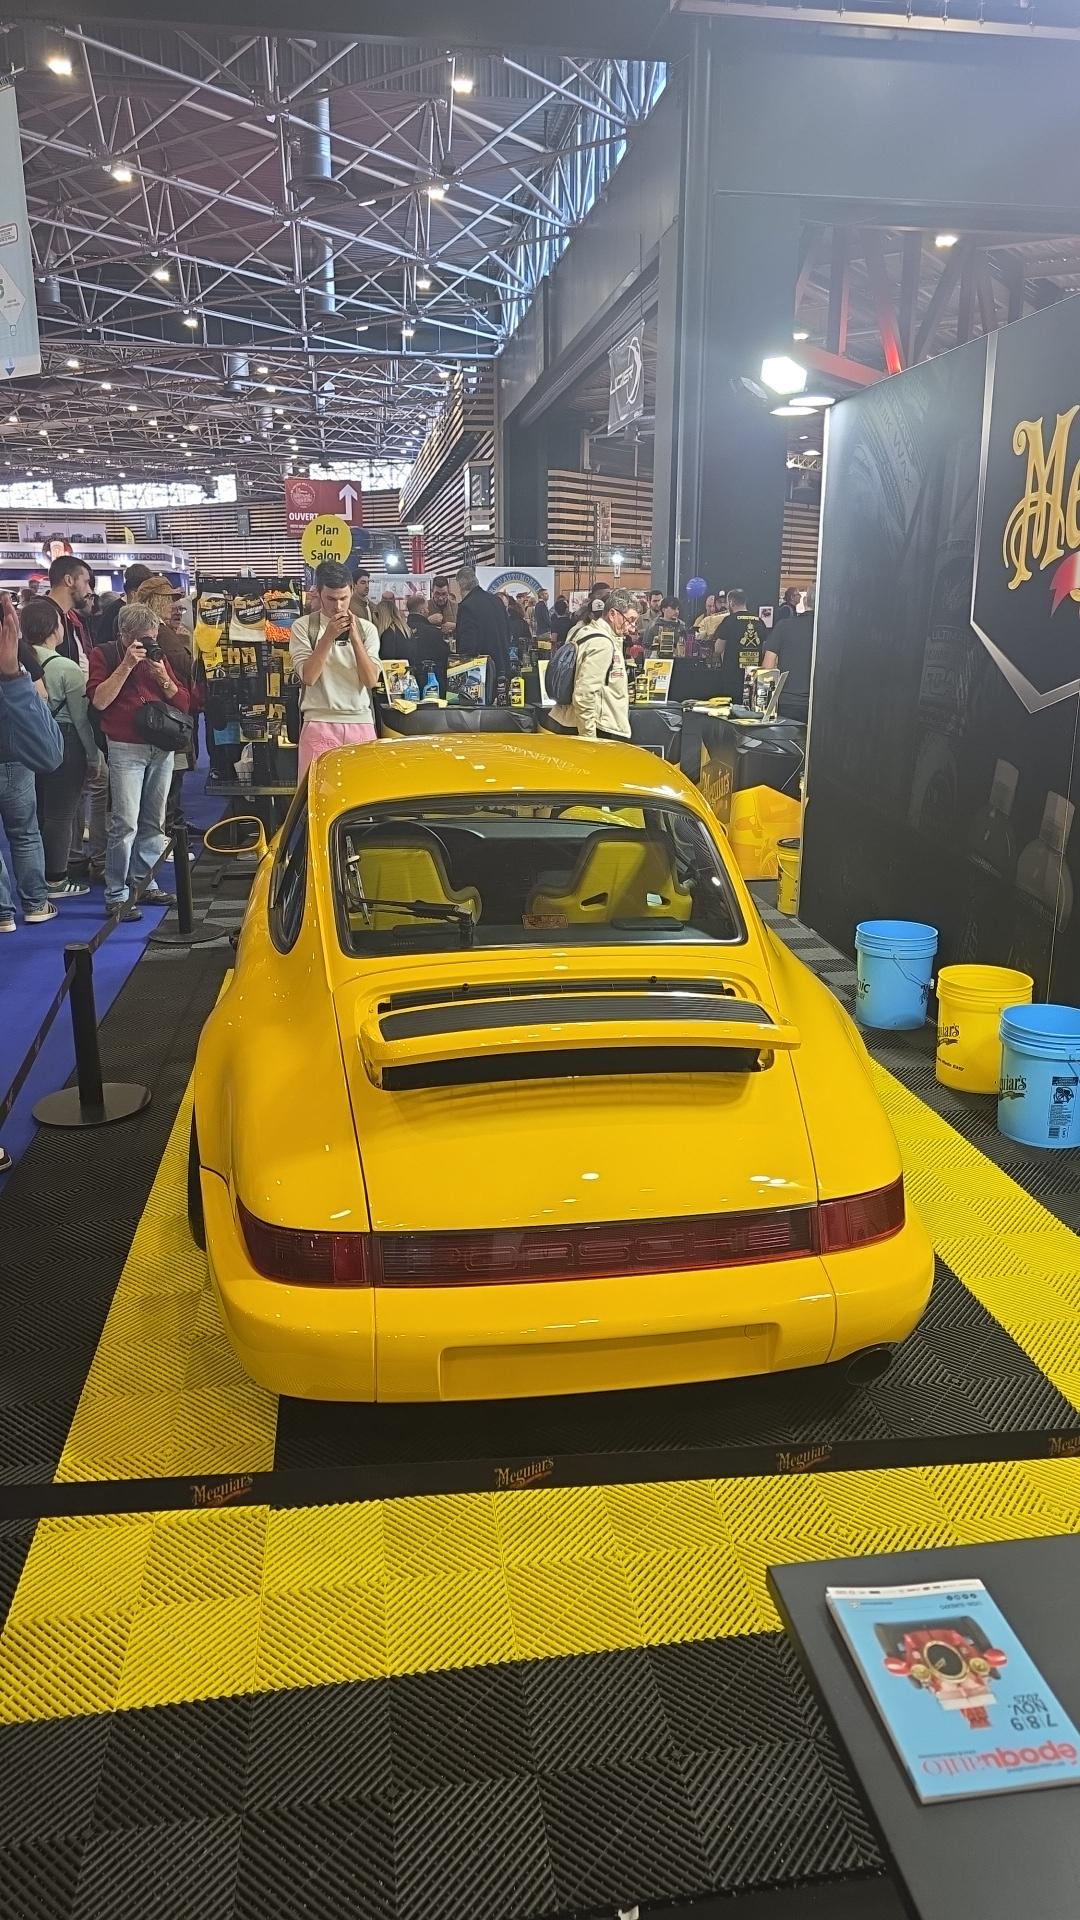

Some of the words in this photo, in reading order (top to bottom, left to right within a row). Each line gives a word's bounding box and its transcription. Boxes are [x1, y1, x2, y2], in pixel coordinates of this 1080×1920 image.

[289, 512, 319, 521] OUVERT
[315, 524, 339, 535] Plan
[320, 538, 333, 547] du
[311, 549, 341, 561] Salon
[494, 1456, 555, 1489] Meguiar's
[190, 1474, 253, 1506] Meguiar's
